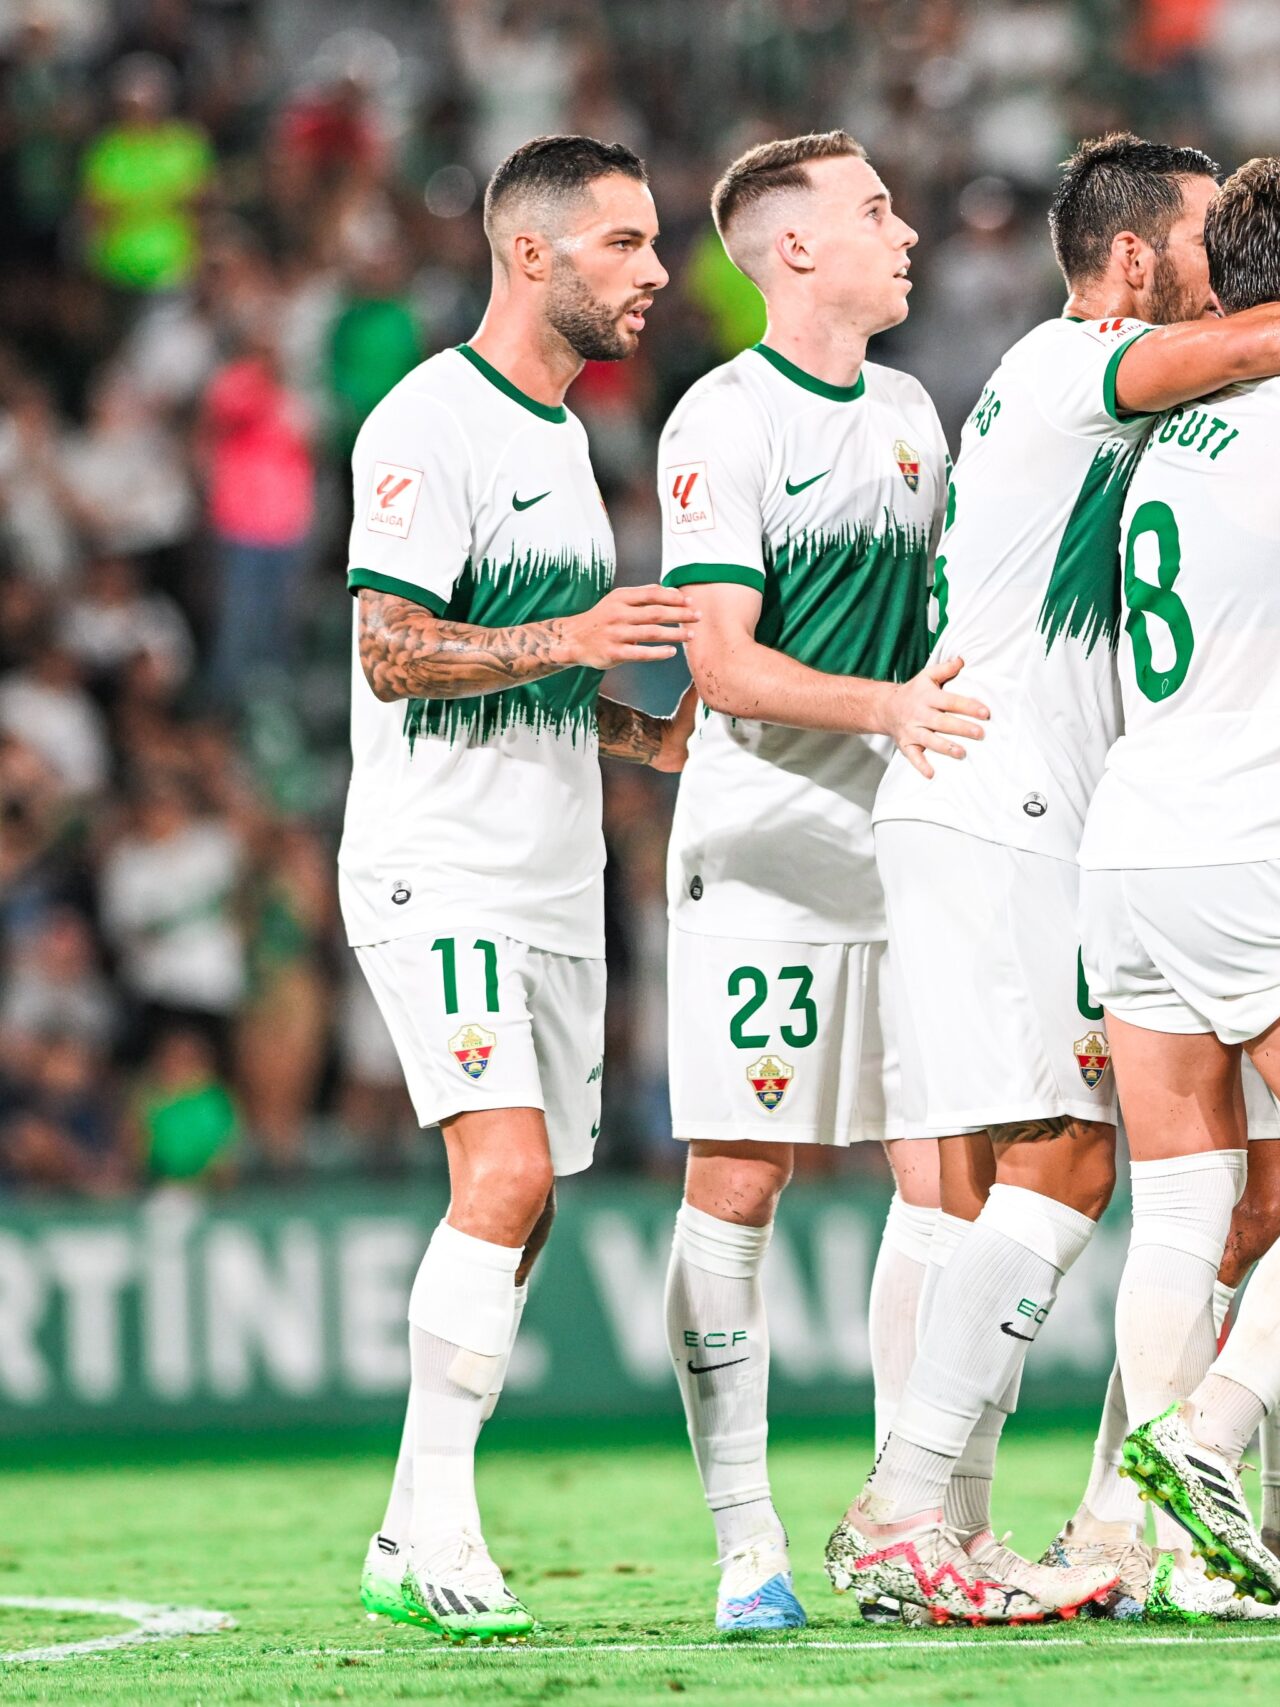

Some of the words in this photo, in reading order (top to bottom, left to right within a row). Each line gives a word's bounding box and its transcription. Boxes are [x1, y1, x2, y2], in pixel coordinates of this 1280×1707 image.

[371, 511, 403, 528] LALIGA
[1124, 501, 1195, 703] 8
[431, 937, 500, 1015] 11
[727, 965, 818, 1049] 23
[0, 1187, 545, 1402] RTÍNE
[683, 1330, 748, 1348] ECF
